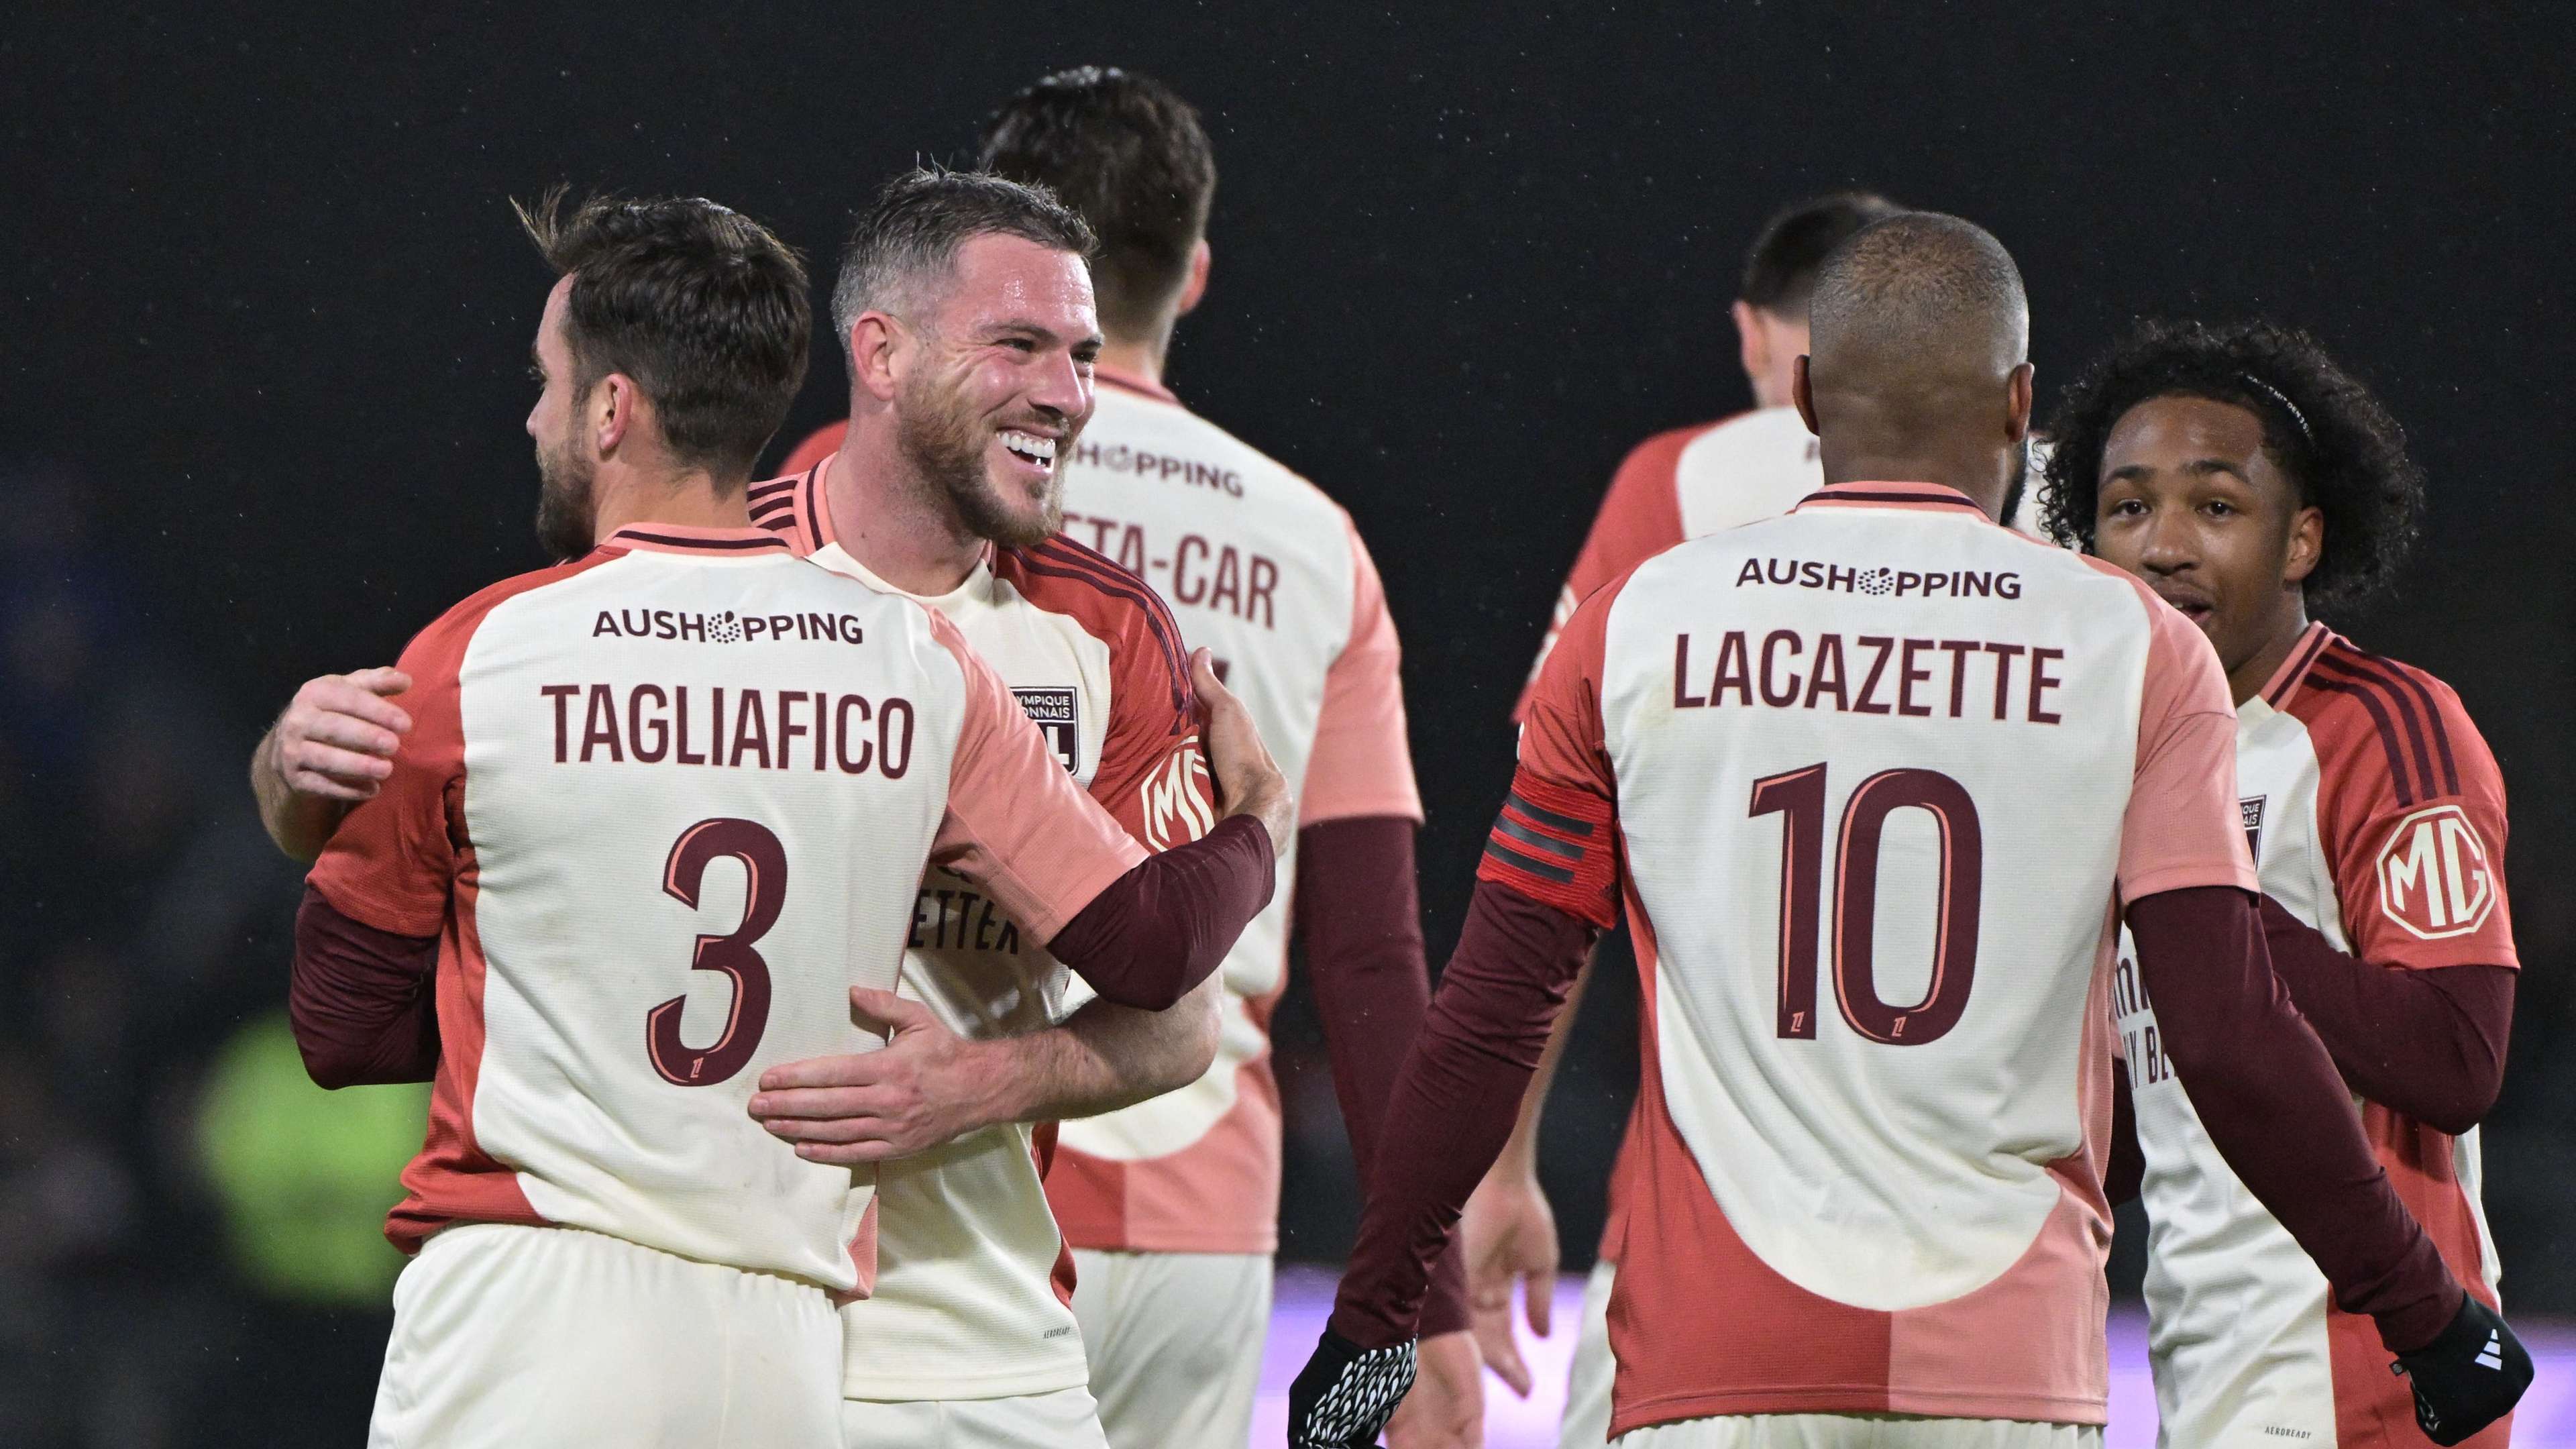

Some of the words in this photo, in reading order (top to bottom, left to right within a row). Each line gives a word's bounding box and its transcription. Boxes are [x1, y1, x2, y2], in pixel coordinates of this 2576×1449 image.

[1076, 442, 1244, 498] HOPPING
[1062, 511, 1279, 629] TA-CAR
[1736, 558, 2022, 600] AUSHOPPING
[592, 608, 863, 645] AUSHOPPING
[1016, 695, 1071, 706] YMPIQUE
[1674, 629, 2065, 726] LACAZETTE
[540, 683, 915, 780] TAGLIAFICO
[1021, 706, 1071, 718] ONNAIS
[1748, 761, 1983, 1046] 10
[2388, 817, 2487, 927] MG
[646, 817, 788, 1087] 3
[907, 889, 1019, 955] ETTE
[2264, 1426, 2312, 1440] AEROREADY
